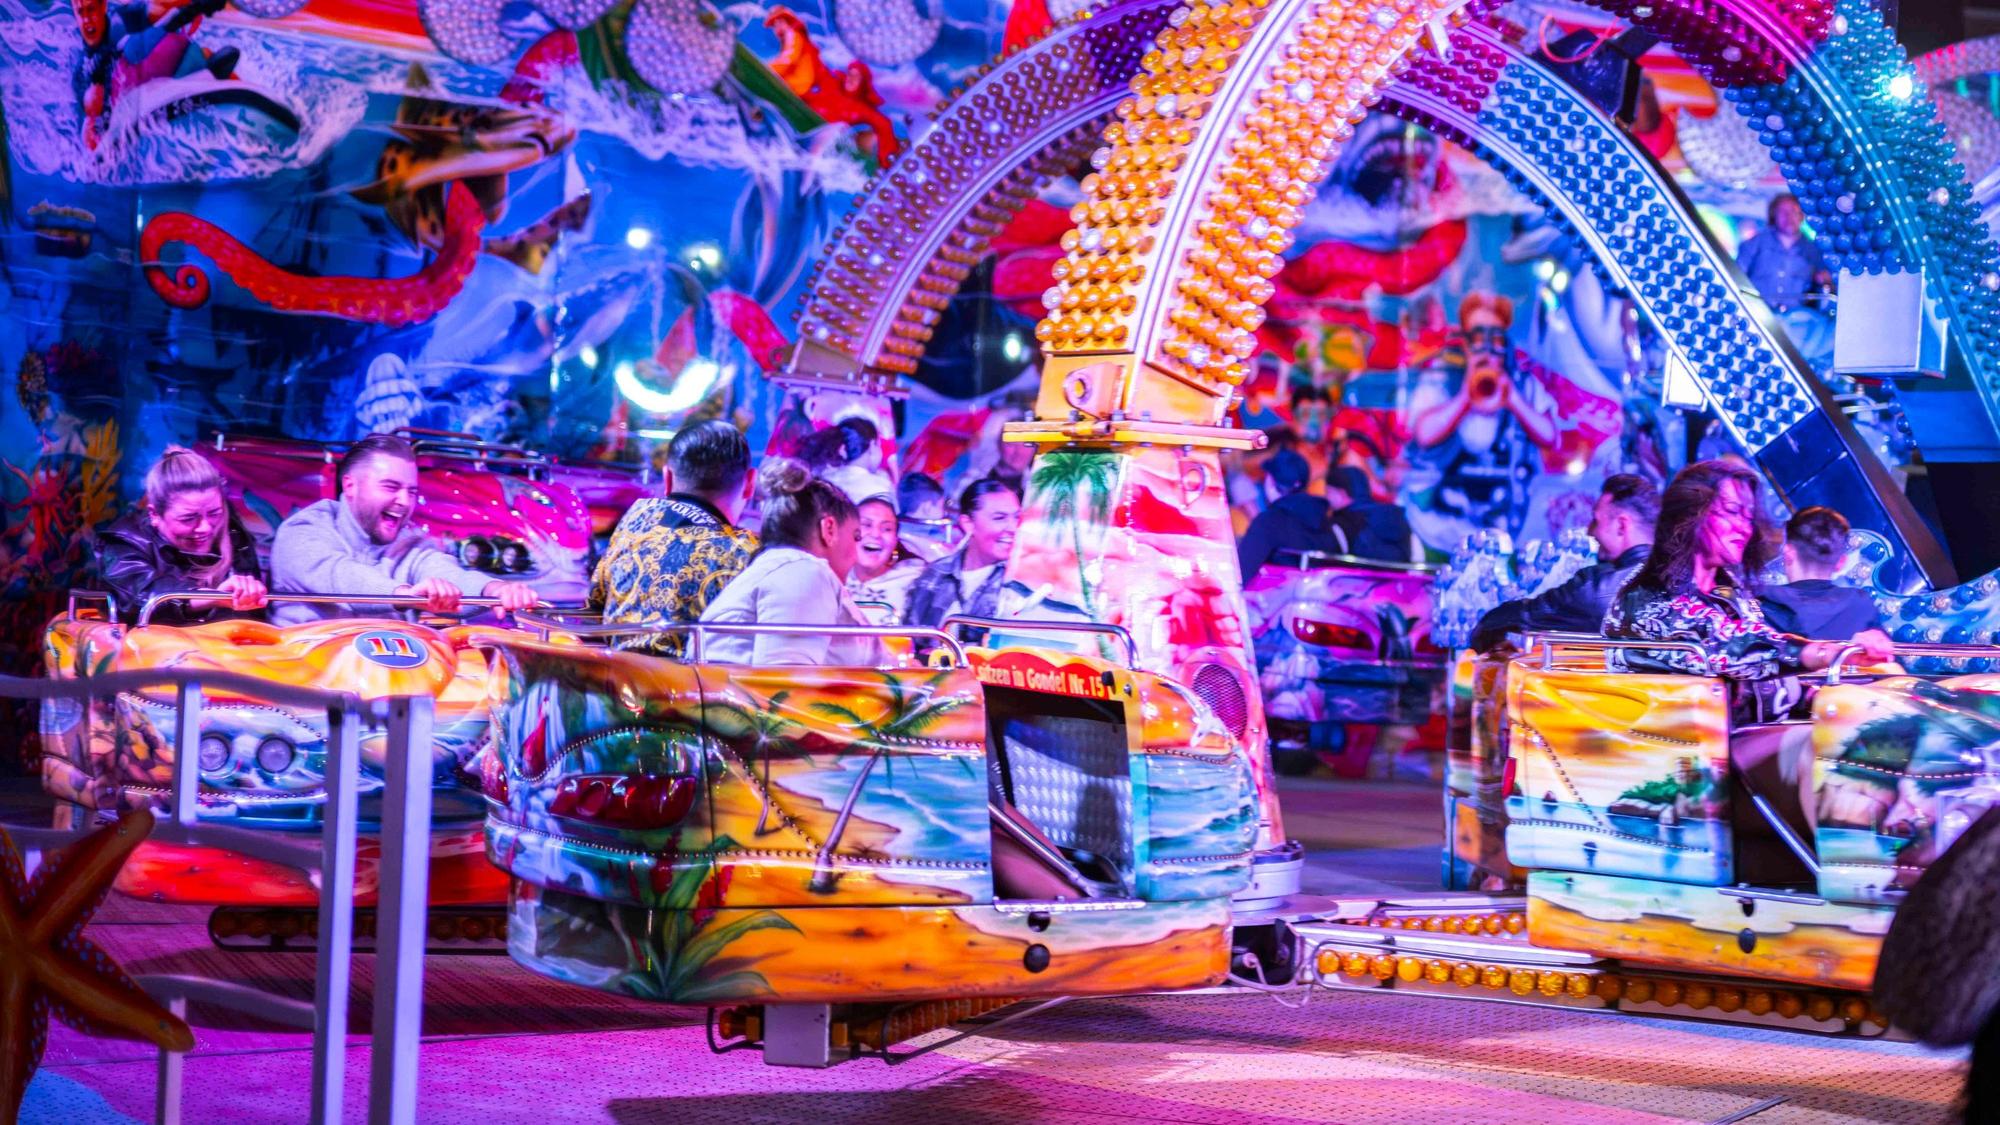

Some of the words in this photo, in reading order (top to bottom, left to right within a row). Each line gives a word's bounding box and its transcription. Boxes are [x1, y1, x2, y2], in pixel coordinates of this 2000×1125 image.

[364, 636, 418, 658] 11
[1011, 664, 1025, 687] in
[1026, 667, 1067, 693] Gondel
[1068, 673, 1089, 695] Nr.
[1088, 675, 1105, 698] 15
